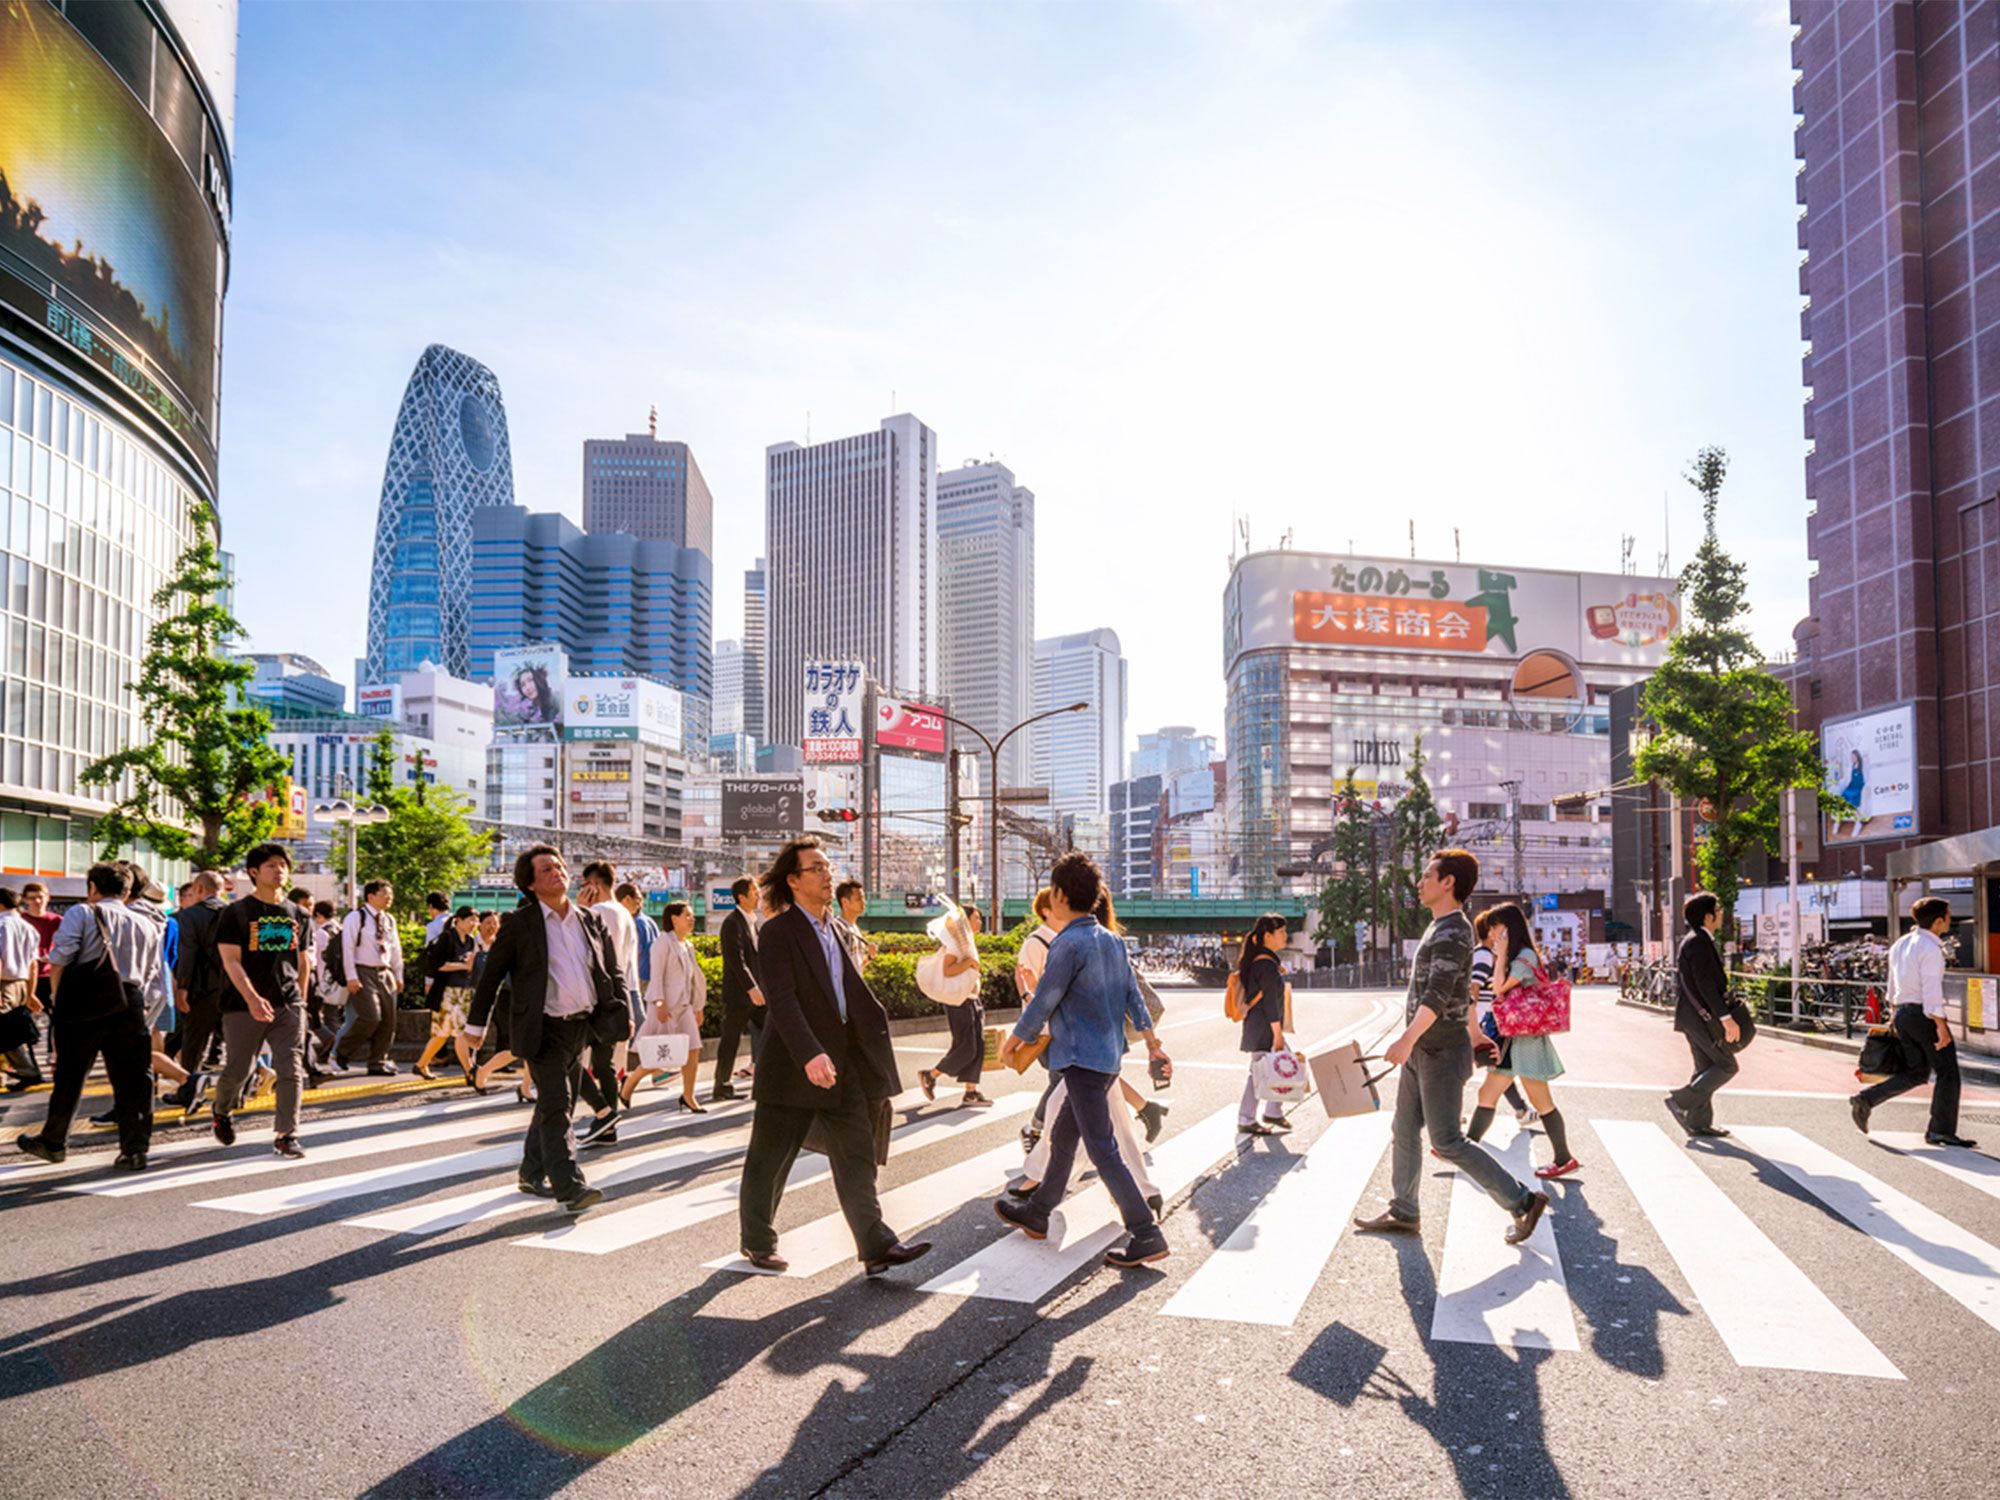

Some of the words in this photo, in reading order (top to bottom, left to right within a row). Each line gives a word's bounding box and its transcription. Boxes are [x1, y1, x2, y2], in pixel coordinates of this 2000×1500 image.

[1331, 564, 1450, 599] たのめーる
[1311, 605, 1472, 639] 大塚商会
[806, 664, 860, 692] カラオケ
[596, 693, 631, 702] シェーン
[826, 692, 839, 711] の
[596, 703, 630, 713] 英会話
[810, 709, 855, 735] 鉄人
[910, 713, 943, 731] アコム
[1873, 786, 1890, 795] Can
[1897, 783, 1910, 791] Do
[741, 803, 776, 820] global
